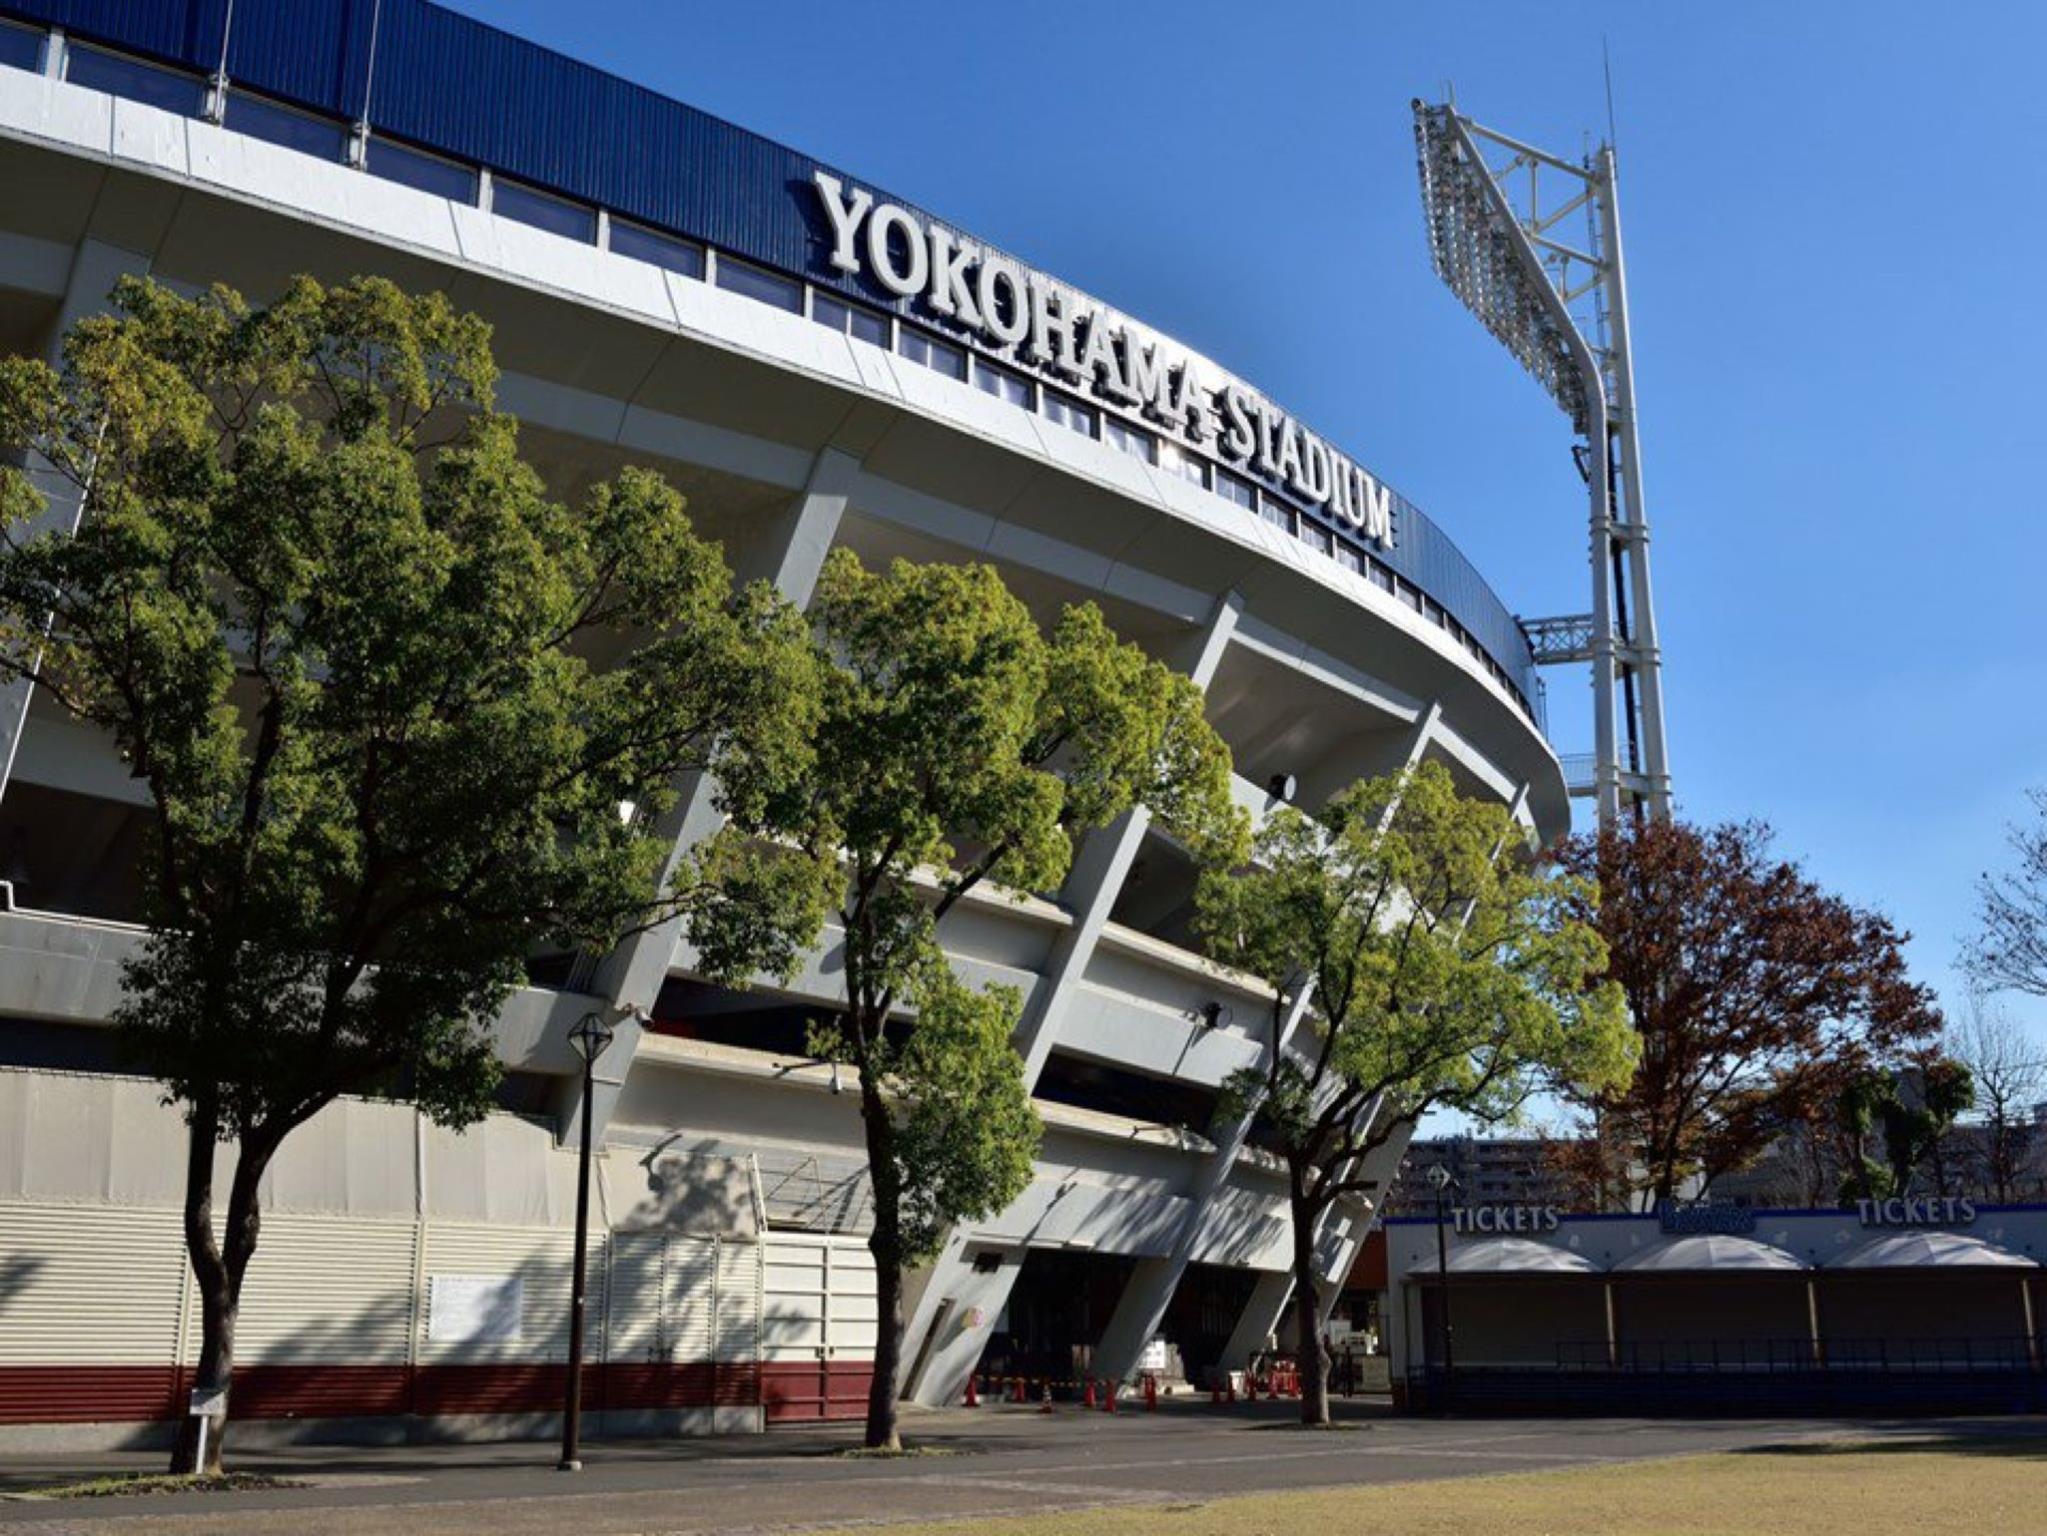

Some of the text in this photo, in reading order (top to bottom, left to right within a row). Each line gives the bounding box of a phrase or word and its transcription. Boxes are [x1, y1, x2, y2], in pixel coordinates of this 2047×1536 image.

[814, 170, 1394, 549] YOKOHAMA STADIUM
[1451, 1205, 1559, 1233] TICKETS
[1855, 1196, 1976, 1224] TICKETS
